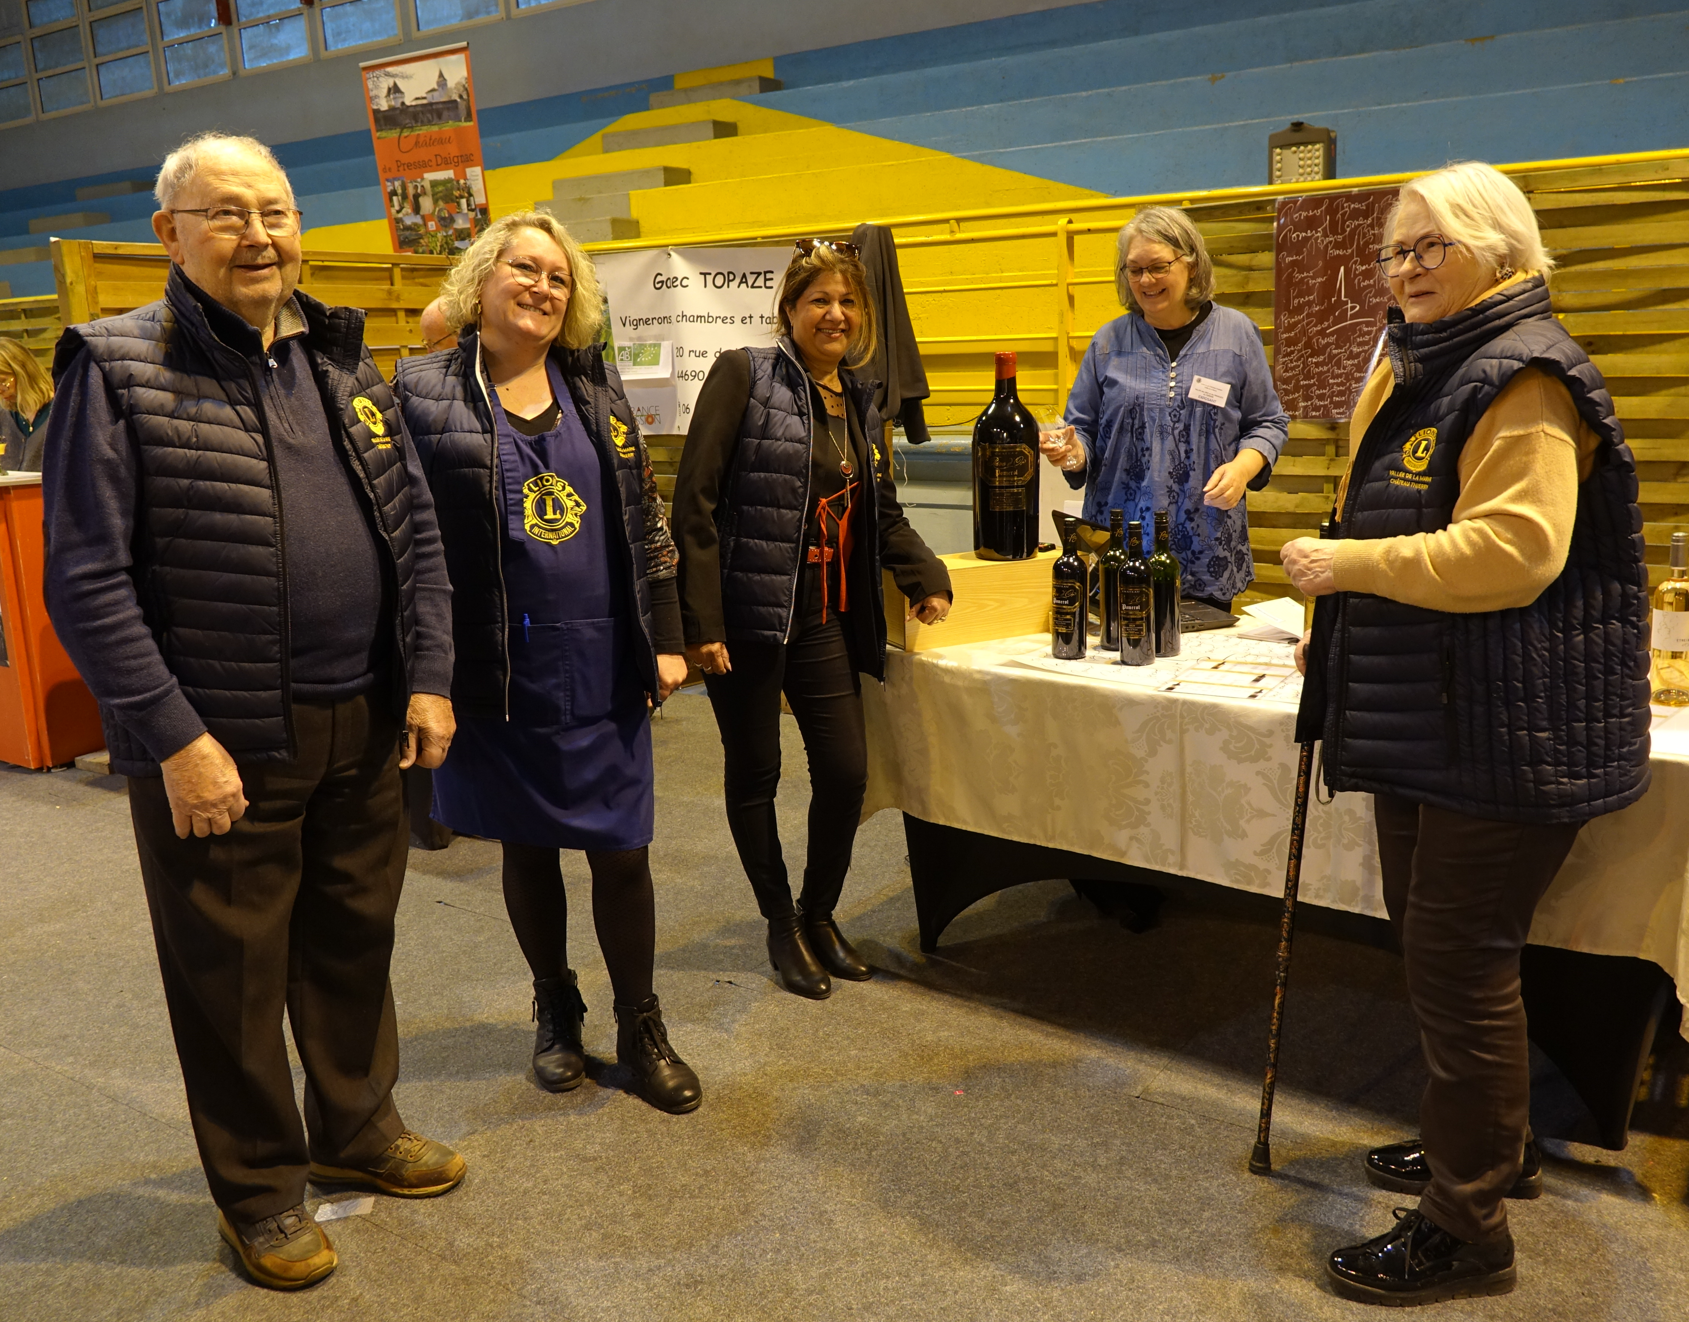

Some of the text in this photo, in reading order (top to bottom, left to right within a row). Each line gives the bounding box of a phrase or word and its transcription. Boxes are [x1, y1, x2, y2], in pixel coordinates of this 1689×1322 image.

[398, 122, 453, 153] Château
[382, 152, 474, 174] de Pressac Daignac
[653, 270, 774, 290] Gaec TOPAZE
[676, 310, 735, 325] chambres
[740, 313, 754, 325] et
[688, 349, 708, 358] rue
[1414, 440, 1428, 457] L
[542, 495, 561, 520] L
[531, 524, 575, 539] INTERNATIONAL
